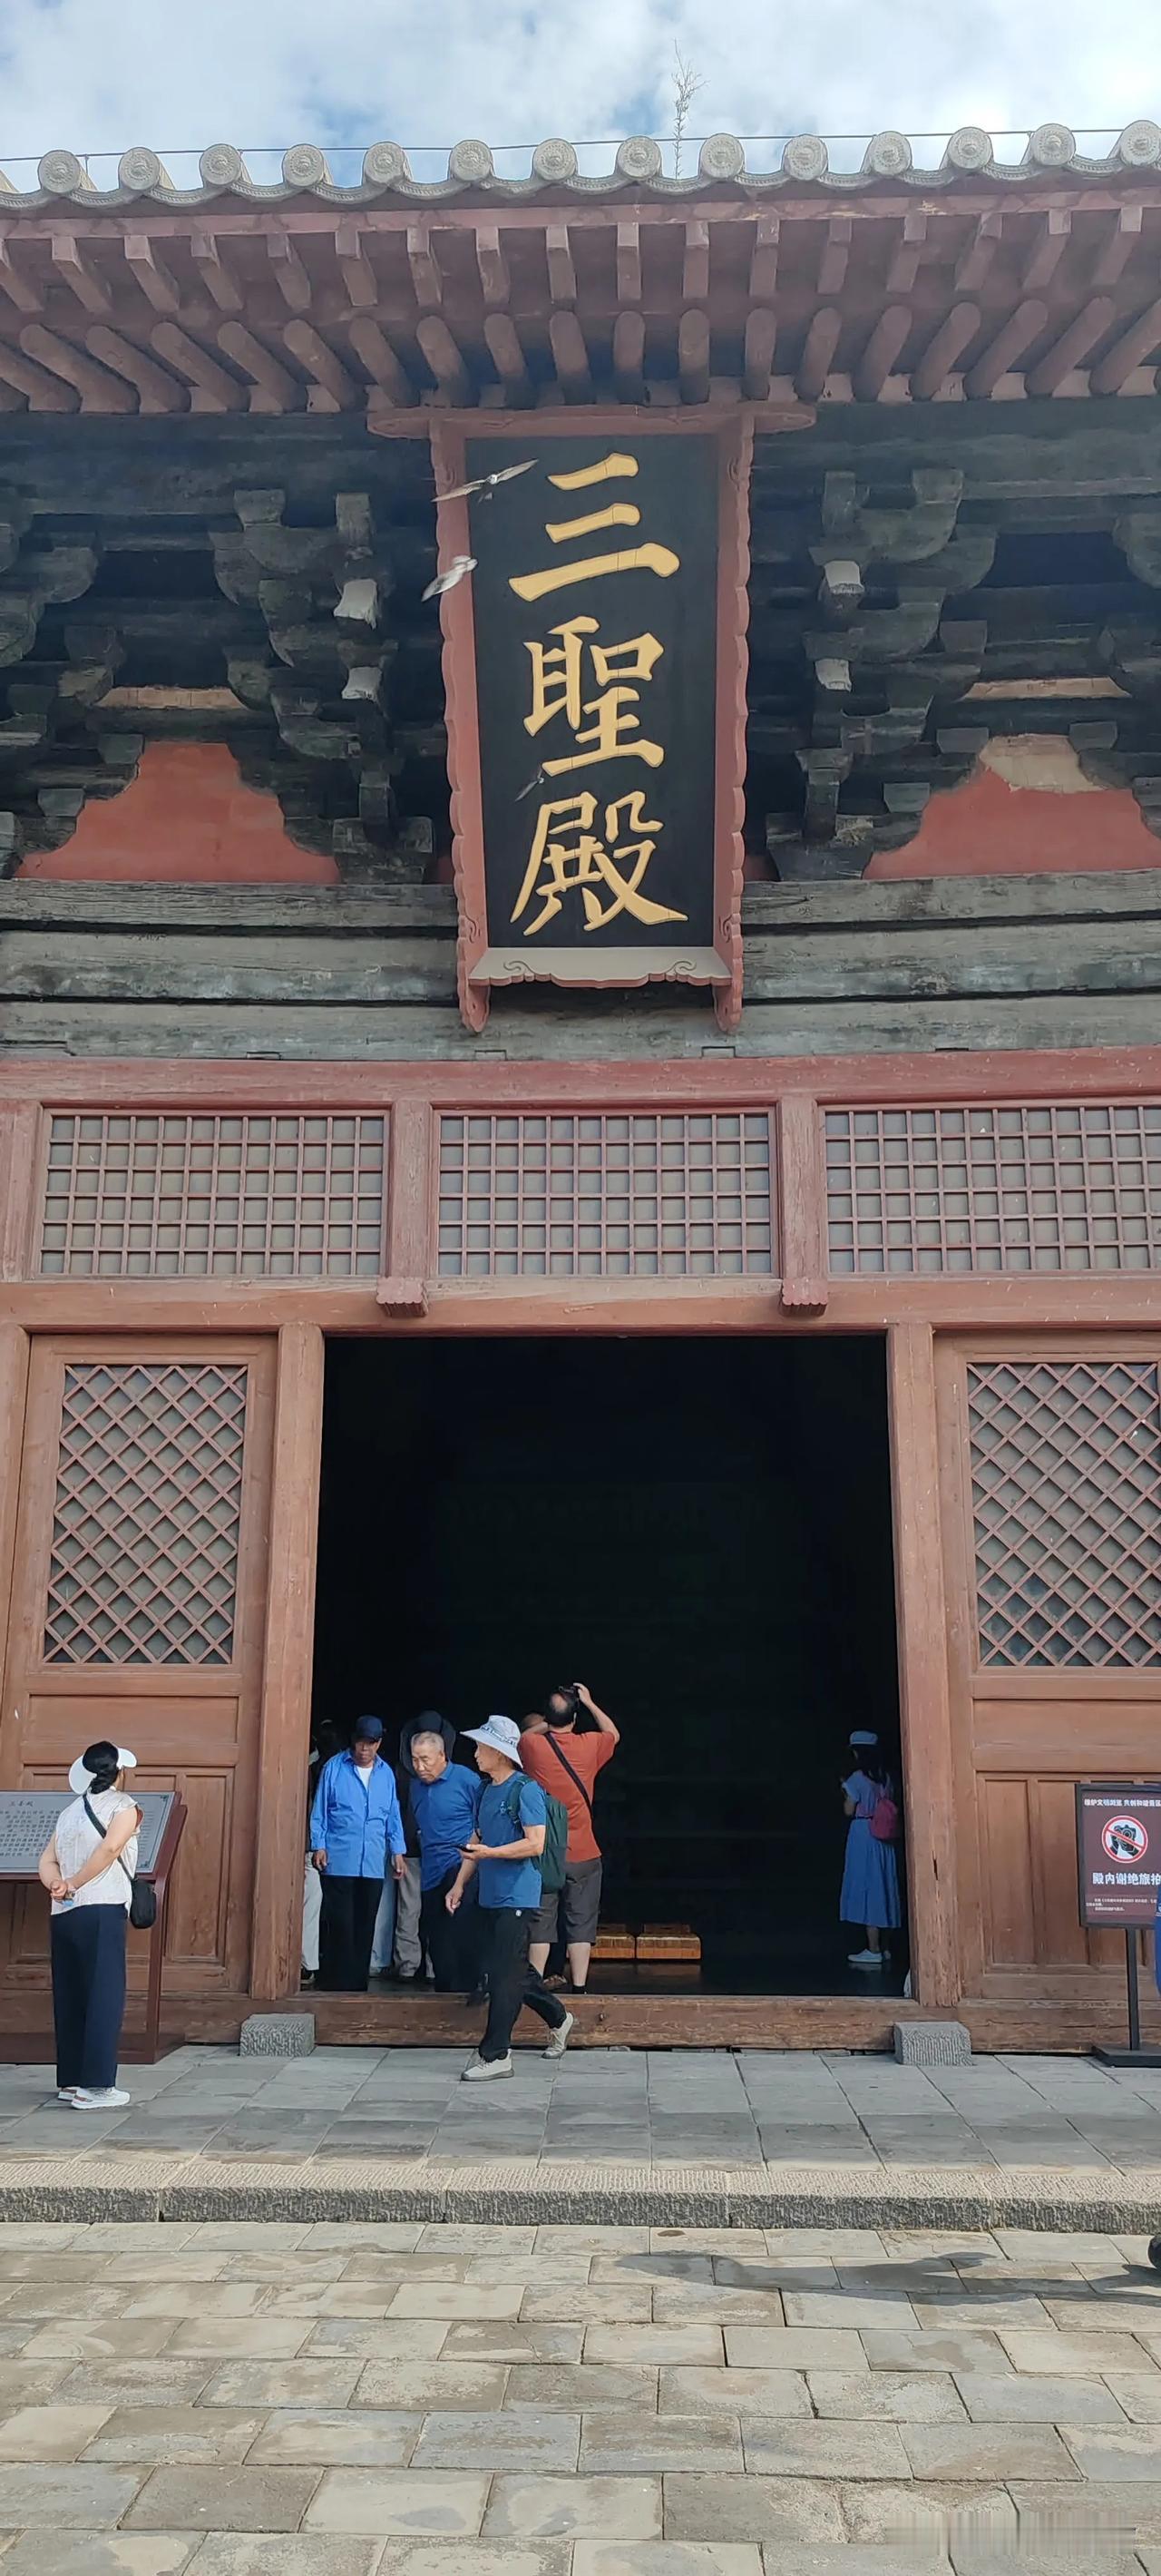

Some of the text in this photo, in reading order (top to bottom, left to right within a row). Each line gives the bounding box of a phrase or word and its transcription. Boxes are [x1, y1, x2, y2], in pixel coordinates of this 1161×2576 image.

[509, 452, 688, 935] 三聖殿
[1092, 1872, 1161, 1885] 殿内谢绝旅拍
